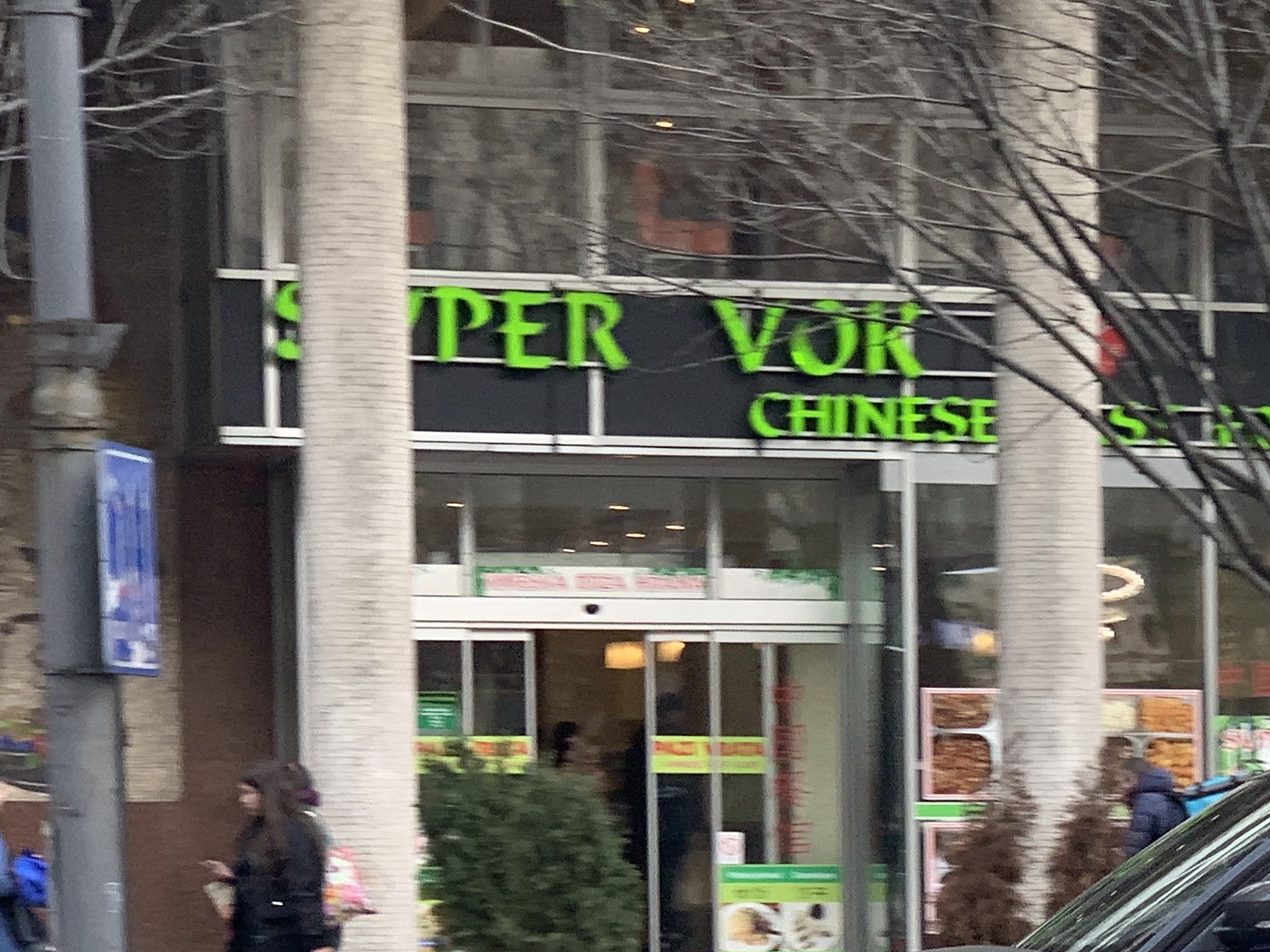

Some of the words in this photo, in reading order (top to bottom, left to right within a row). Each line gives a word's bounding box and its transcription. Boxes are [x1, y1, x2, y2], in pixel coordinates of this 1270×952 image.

[274, 284, 630, 370] PER
[711, 299, 924, 378] VOK
[748, 391, 998, 443] CHINESE
